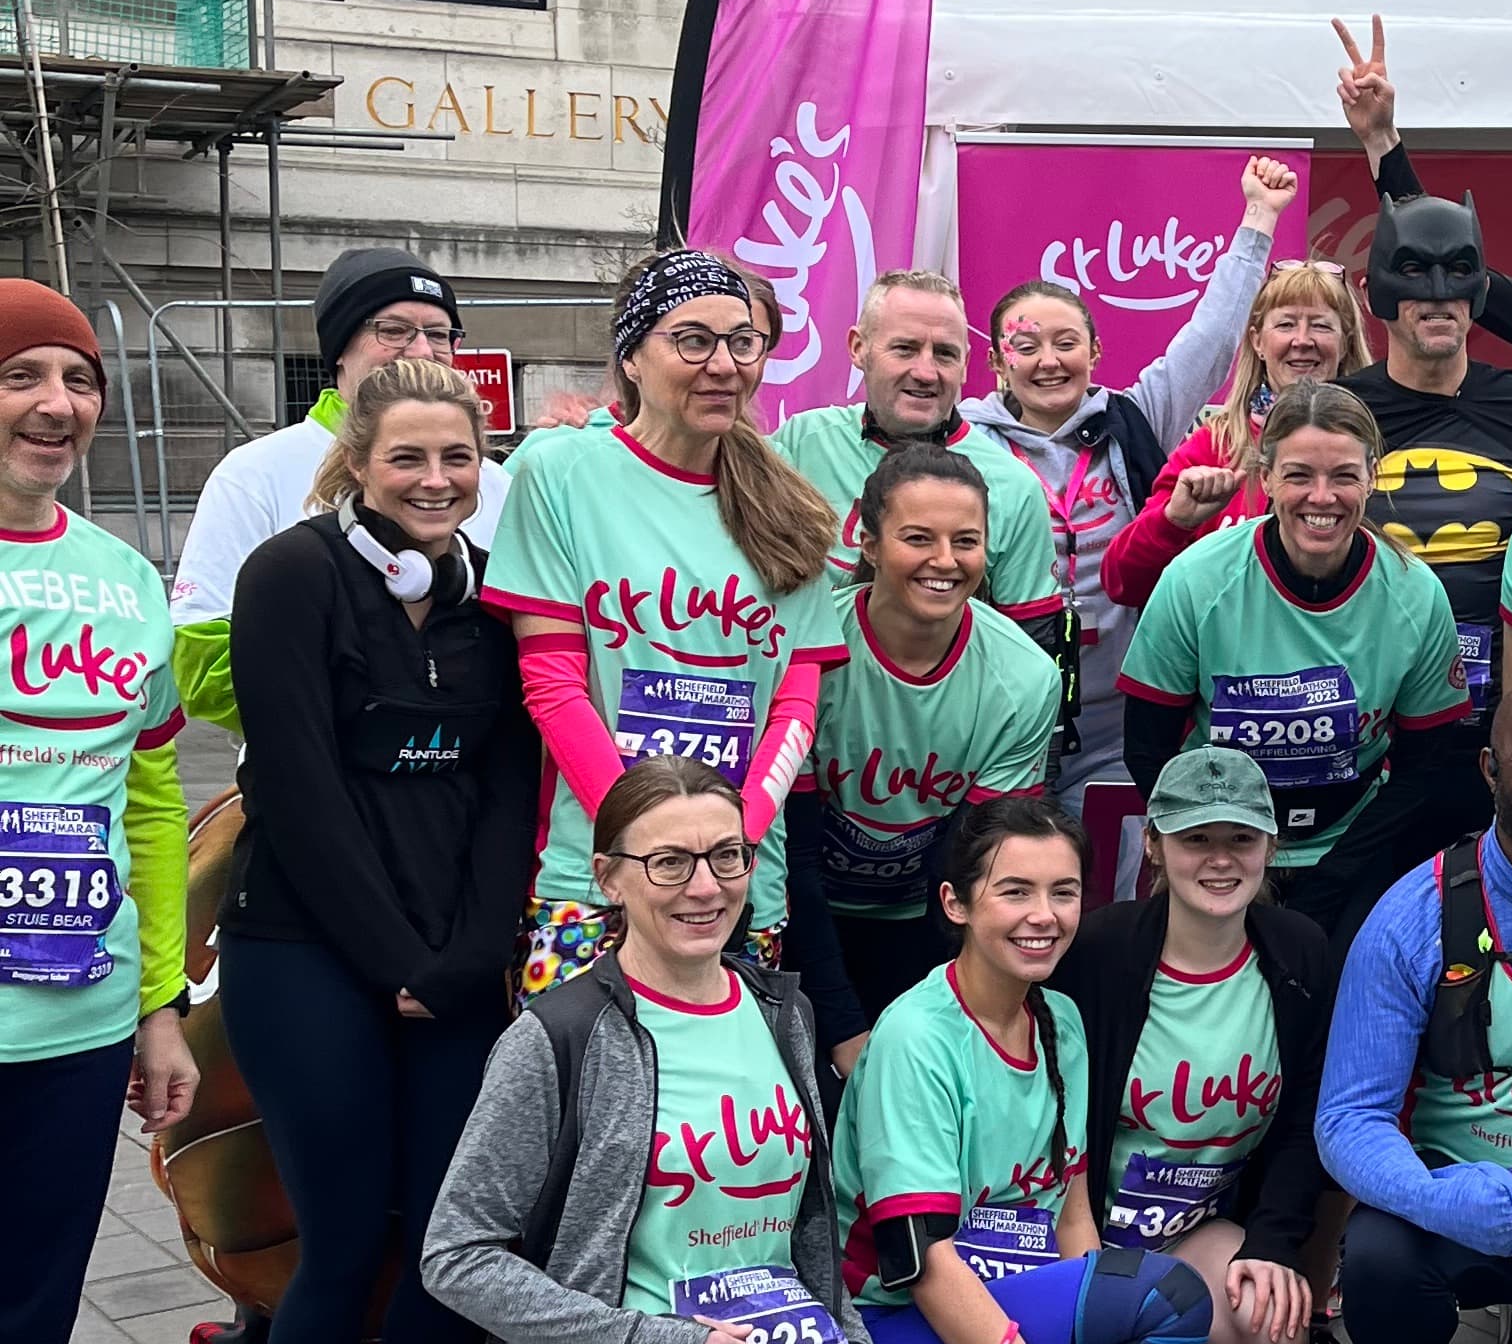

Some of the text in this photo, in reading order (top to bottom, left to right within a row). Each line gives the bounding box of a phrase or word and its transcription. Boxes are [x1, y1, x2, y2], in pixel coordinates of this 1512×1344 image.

[1041, 237, 1100, 297] St
[585, 566, 786, 658] St Luke's
[1460, 646, 1480, 657] 023
[676, 680, 726, 694] SHEFFIELD
[1253, 676, 1299, 689] SHEFFIELD
[1253, 678, 1338, 697] HALF MARATHON
[675, 691, 750, 707] HALF MARATHON
[1306, 689, 1340, 705] 2023
[725, 707, 750, 720] 2023
[1238, 716, 1336, 747] 3208
[399, 749, 461, 760] RUNITUDE
[648, 729, 740, 769] 3754
[1245, 744, 1337, 757] HEFFIELDDIVING
[24, 809, 82, 823] SHEFFIELD
[0, 867, 110, 909] 3318
[6, 913, 94, 928] STUIE BEAR
[646, 1122, 717, 1208] St
[971, 1208, 1017, 1222] SHEFFIELD
[971, 1218, 1048, 1236] HALF MARATHON
[1018, 1235, 1047, 1250] 2023
[727, 1270, 772, 1287] SHEFFIELD
